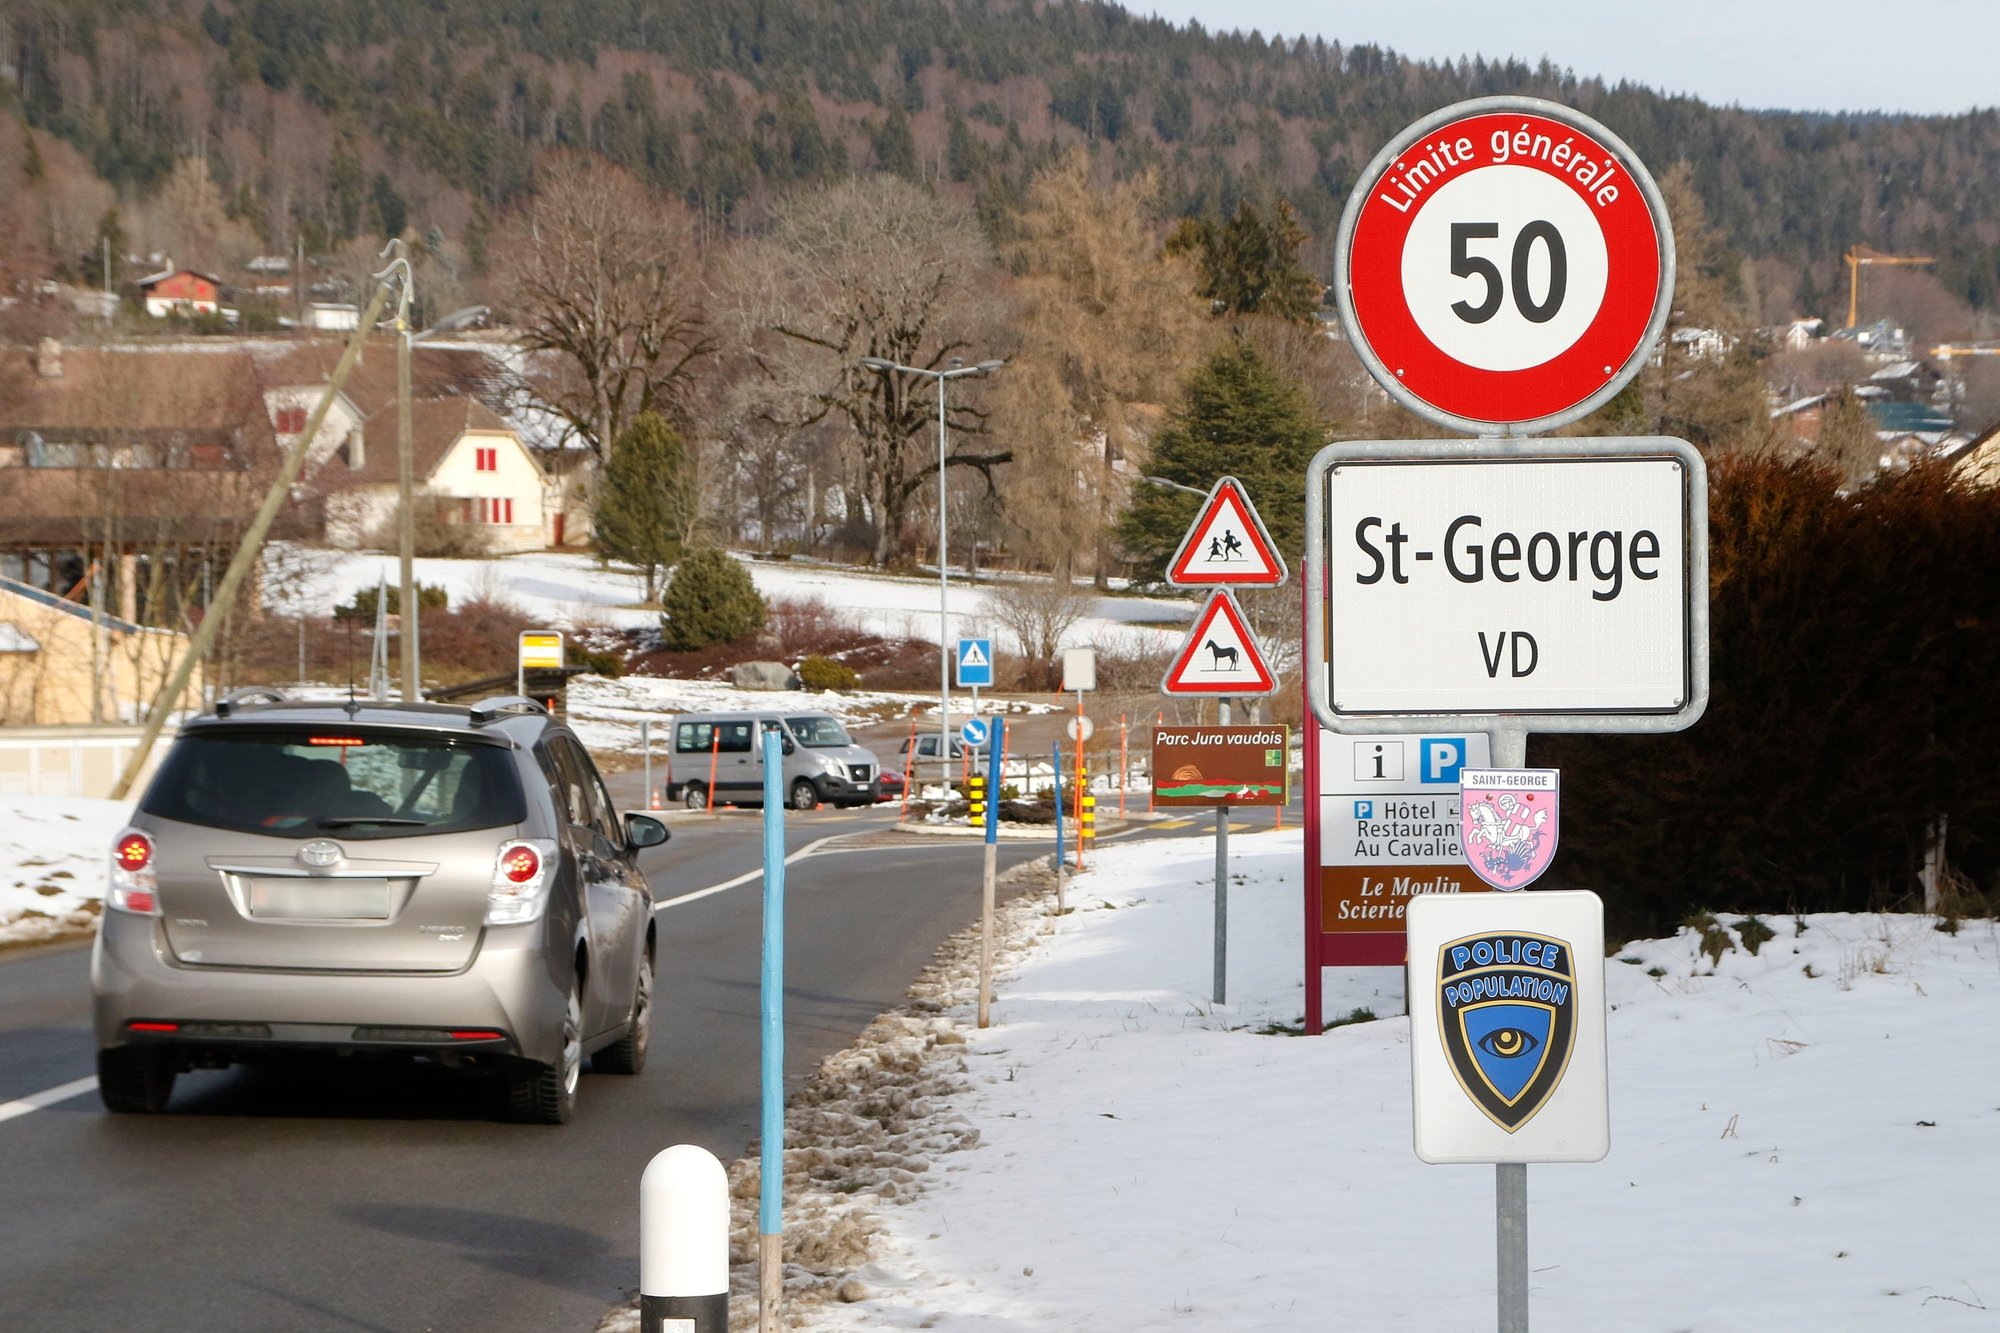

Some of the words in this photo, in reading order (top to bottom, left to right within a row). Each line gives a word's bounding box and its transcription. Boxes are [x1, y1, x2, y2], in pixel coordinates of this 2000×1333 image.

[1380, 136, 1475, 213] Limite
[1490, 123, 1620, 207] générale
[1450, 220, 1567, 324] 50
[1355, 515, 1661, 601] St-George
[1478, 631, 1539, 678] VD
[1156, 732, 1189, 745] Parc
[1191, 732, 1224, 745] Jura
[1227, 731, 1283, 744] vaudois
[1372, 745, 1386, 778] i
[1430, 743, 1458, 778] P
[1472, 774, 1548, 786] SAINT-GEORGE
[1357, 802, 1370, 817] P
[1385, 801, 1436, 819] Hôtel
[1354, 840, 1380, 856] Au
[1388, 838, 1463, 856] Cavalie
[1360, 877, 1384, 896] Le
[1391, 876, 1461, 896] Moulin
[1338, 900, 1405, 919] Scierie
[1452, 940, 1559, 970] POLICE
[1445, 976, 1568, 1007] POPULATION
